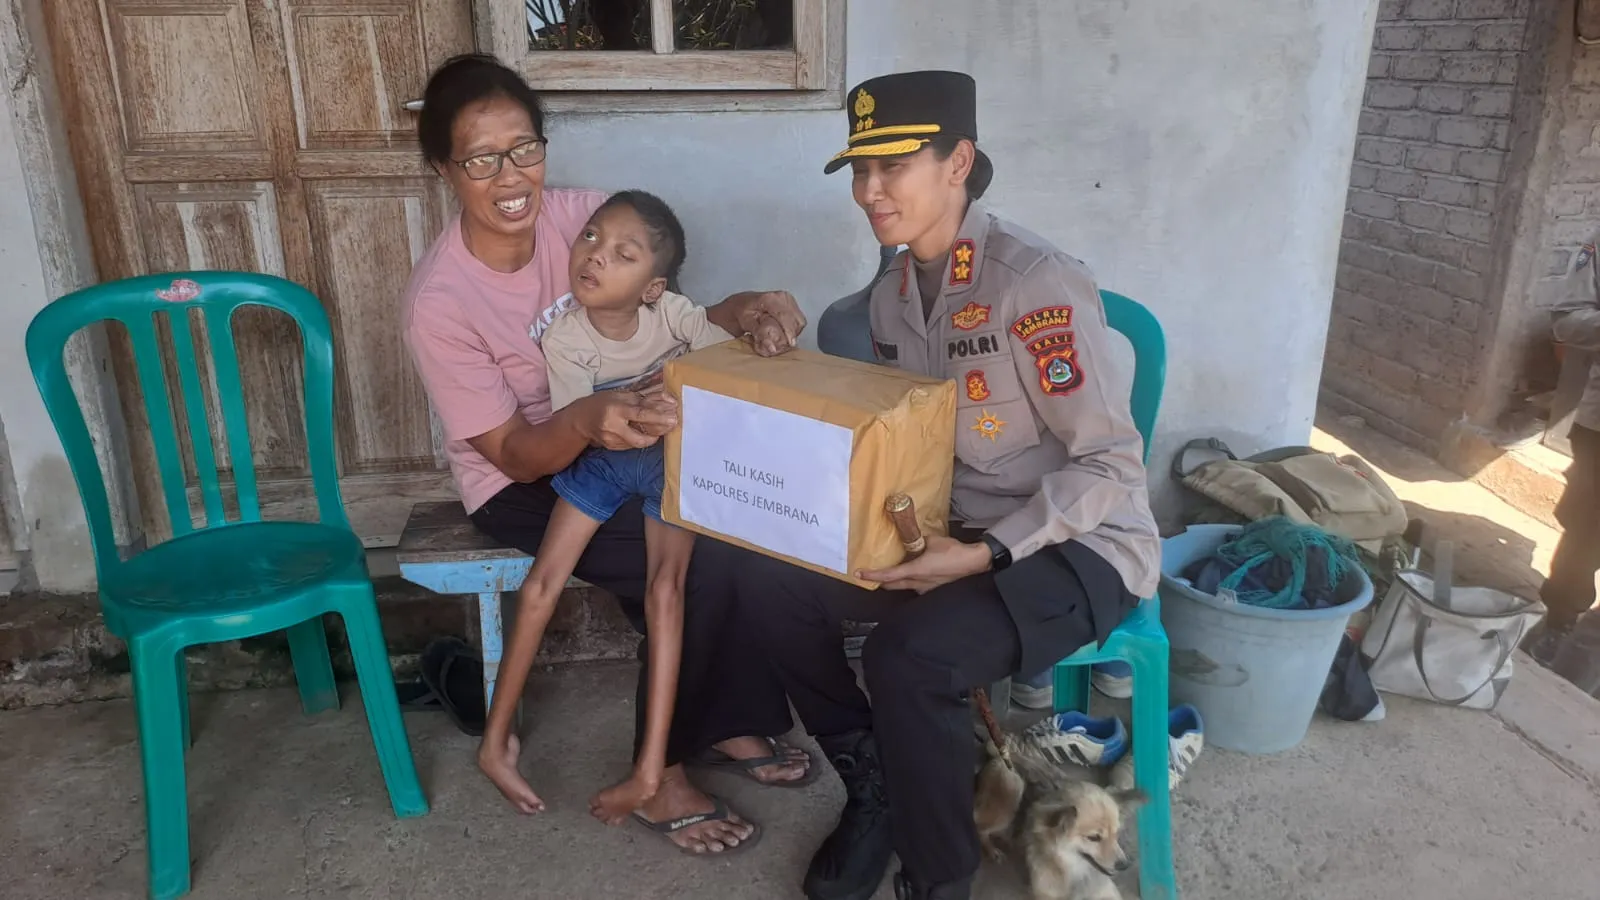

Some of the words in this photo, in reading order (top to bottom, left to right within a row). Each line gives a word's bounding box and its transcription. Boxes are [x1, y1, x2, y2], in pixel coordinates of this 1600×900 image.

[1015, 309, 1069, 332] POLRES
[1021, 317, 1068, 337] JEMBRANA
[947, 334, 999, 359] POLRI
[1034, 335, 1068, 350] BALI
[723, 460, 747, 477] TALI
[749, 468, 784, 489] KASIH
[692, 475, 749, 503] KAPOLRES
[751, 495, 820, 526] JEMBRANA
